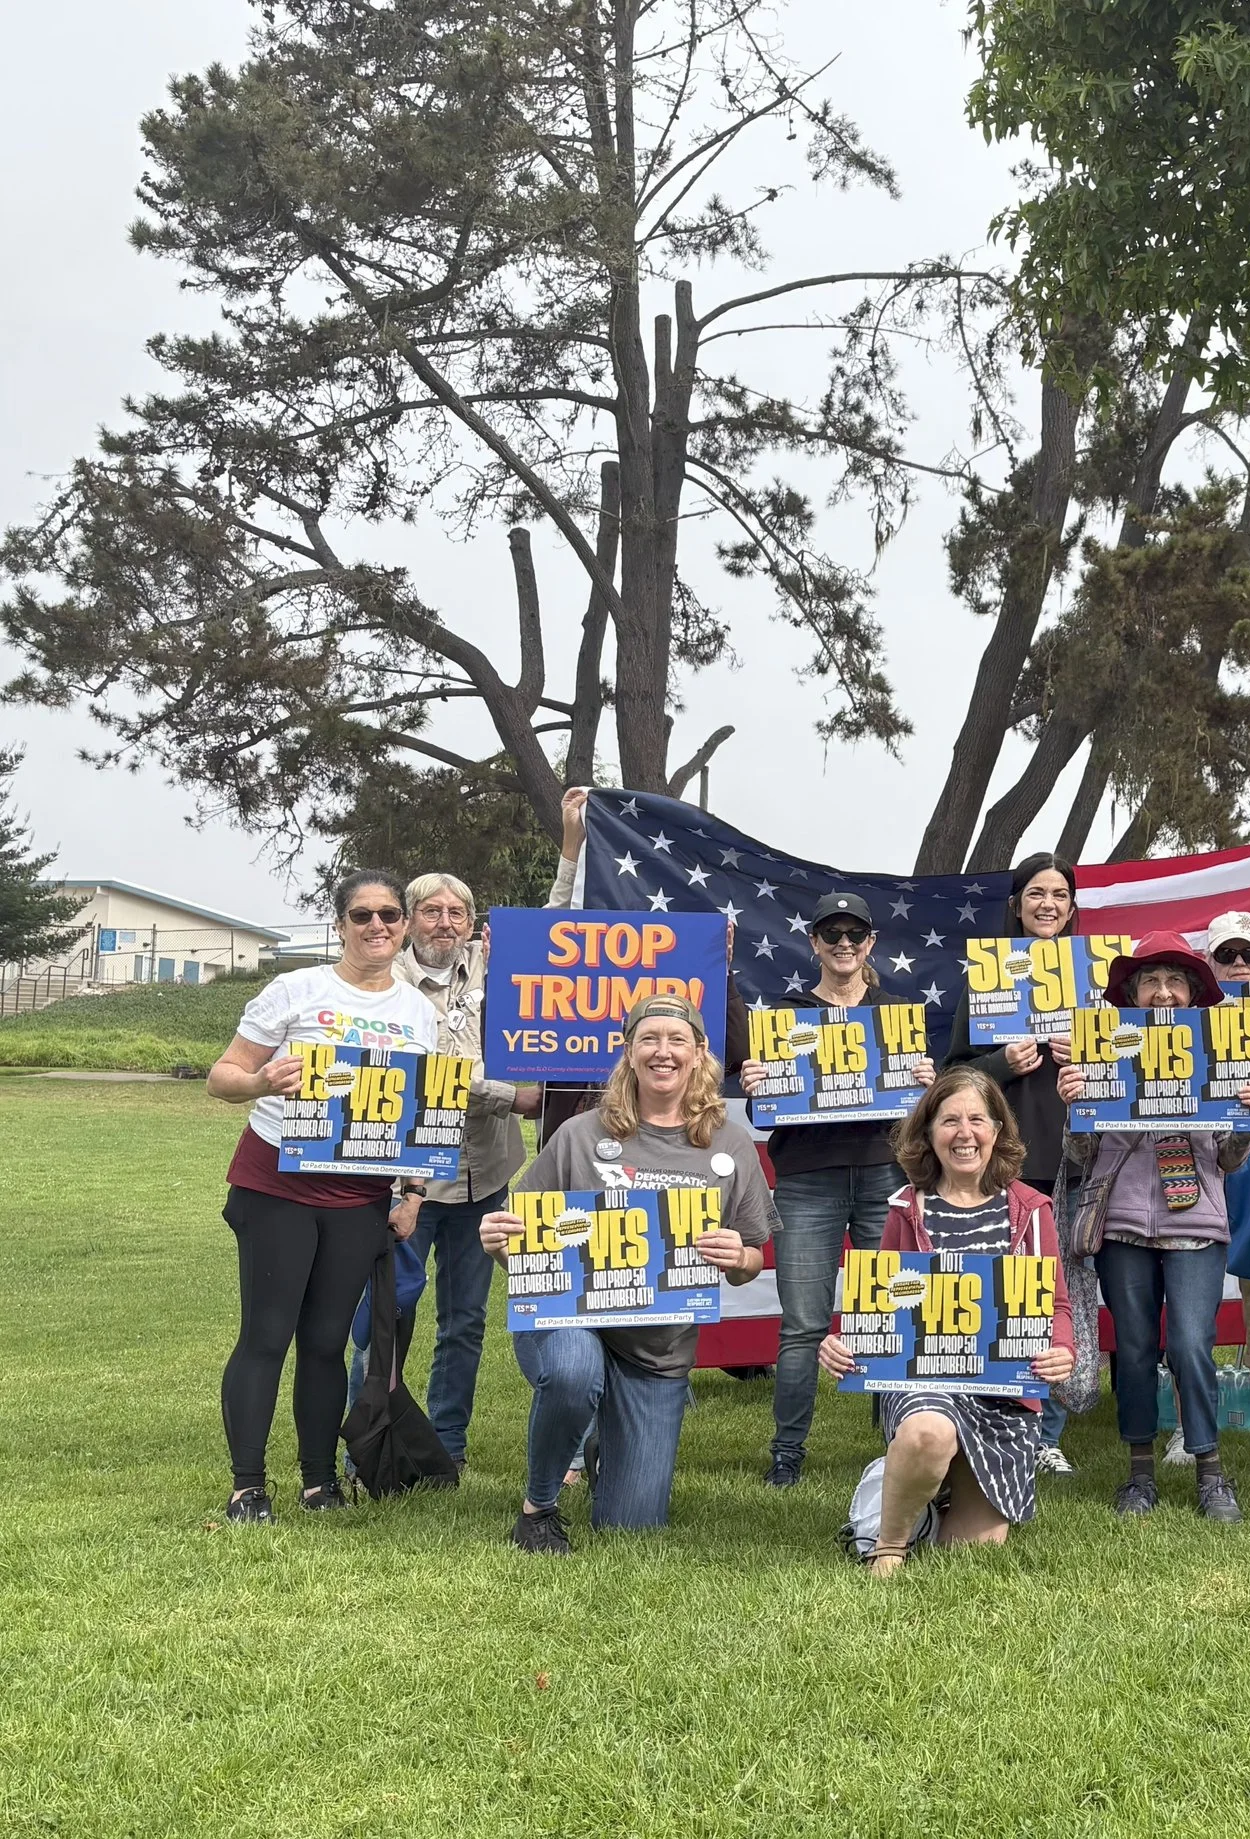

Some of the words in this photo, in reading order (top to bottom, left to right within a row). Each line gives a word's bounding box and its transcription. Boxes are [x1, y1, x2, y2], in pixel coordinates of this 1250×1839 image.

[548, 921, 676, 968] STOP
[1030, 936, 1077, 1011] SI
[828, 1007, 848, 1023] VOTE
[1153, 1008, 1175, 1024] VOTE
[318, 1011, 414, 1040] CHOOSE
[1071, 1008, 1120, 1062] YES
[502, 1030, 558, 1053] YES
[566, 1035, 598, 1053] on
[815, 1022, 868, 1074] YES
[369, 1049, 391, 1067] VOTE
[1140, 1024, 1194, 1079] YES
[822, 1075, 833, 1091] ON
[833, 1073, 854, 1090] PROP
[854, 1072, 866, 1088] 50
[1144, 1080, 1156, 1097] ON
[1157, 1080, 1179, 1097] PROP
[1179, 1079, 1191, 1096] 50
[350, 1066, 407, 1123] YES
[817, 1089, 858, 1107] NOVEMBER
[858, 1088, 873, 1104] 4TH
[1139, 1097, 1183, 1115] NOVEMBER
[1183, 1096, 1198, 1113] 4TH
[350, 1122, 362, 1139] ON
[363, 1122, 385, 1139] PROP
[385, 1123, 397, 1139] 50
[342, 1140, 385, 1157] NOVEMBER
[385, 1141, 401, 1157] 4TH
[634, 1180, 671, 1189] PARTY
[635, 1172, 708, 1188] DEMOCRATIC
[604, 1190, 629, 1209] VOTE
[588, 1208, 649, 1271] YES
[939, 1253, 964, 1272] VOTE
[594, 1271, 607, 1289] ON
[607, 1269, 632, 1289] PROP
[632, 1268, 645, 1286] 50
[842, 1250, 901, 1313] YES
[586, 1288, 636, 1310] NOVEMBER
[636, 1287, 653, 1305] 4TH
[921, 1273, 982, 1335] YES
[841, 1314, 854, 1333] ON
[856, 1314, 881, 1333] PROP
[882, 1314, 895, 1333] 50
[924, 1335, 938, 1354] ON
[938, 1335, 963, 1354] PROP
[963, 1335, 977, 1354] 50
[916, 1355, 967, 1375] NOVEMBER
[966, 1355, 984, 1375] 4TH
[962, 1384, 1001, 1392] Democratic
[1002, 1386, 1020, 1394] Party
